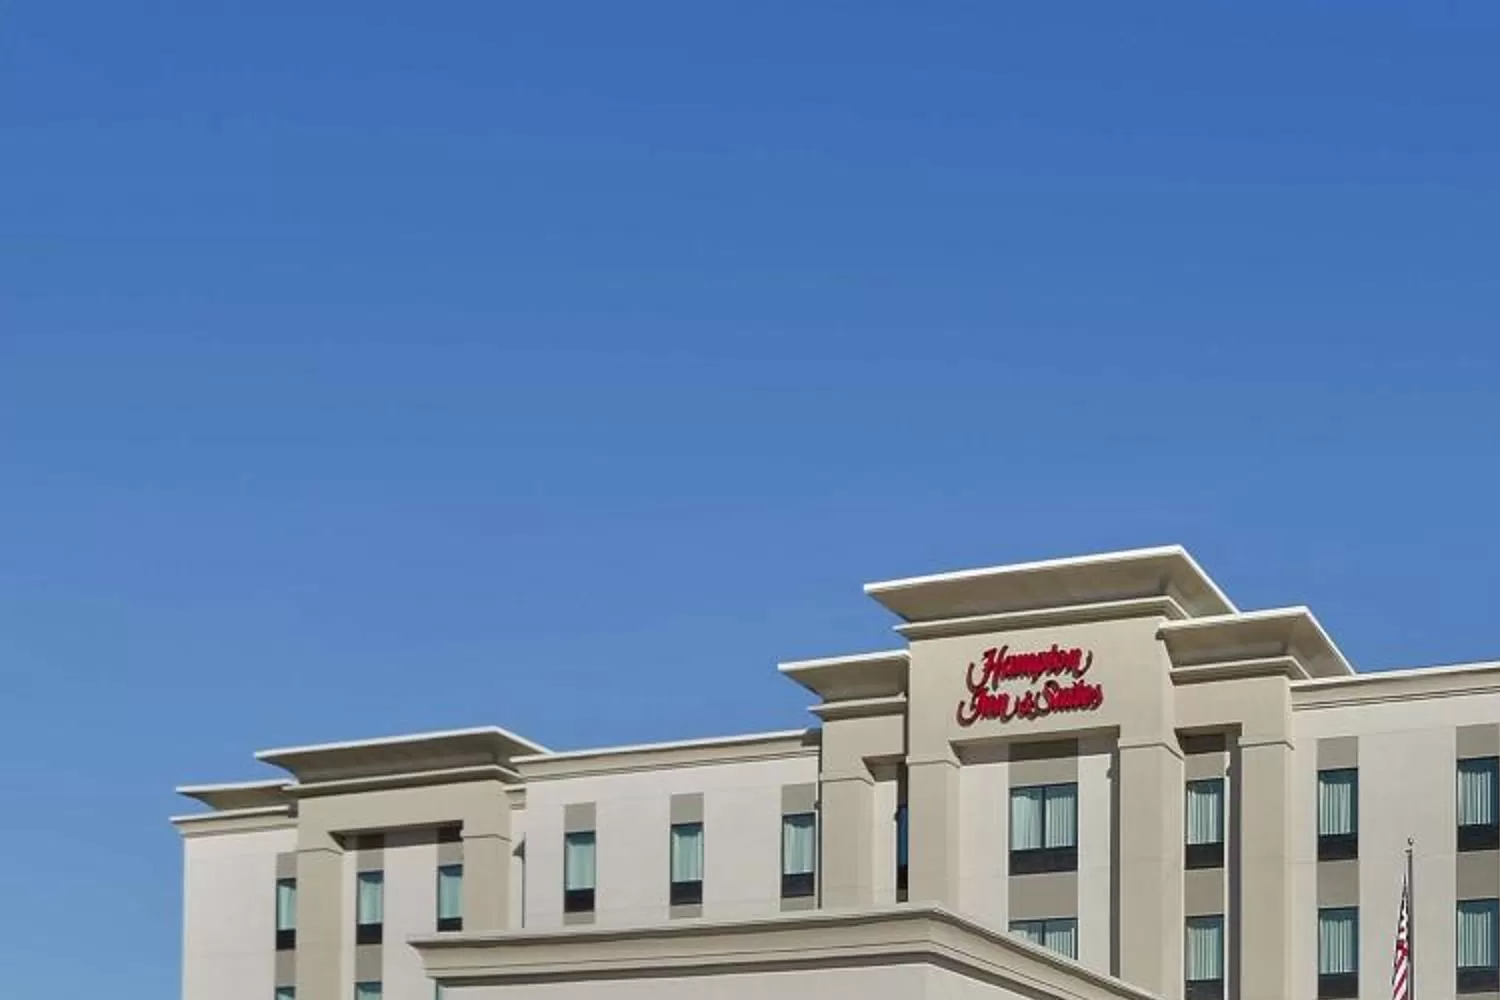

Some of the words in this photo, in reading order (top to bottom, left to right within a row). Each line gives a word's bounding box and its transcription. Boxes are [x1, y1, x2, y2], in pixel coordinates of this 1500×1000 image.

[966, 644, 1092, 692] Hampton
[957, 686, 1019, 727] Inn
[1016, 690, 1036, 721] &
[1034, 680, 1103, 717] Suites
